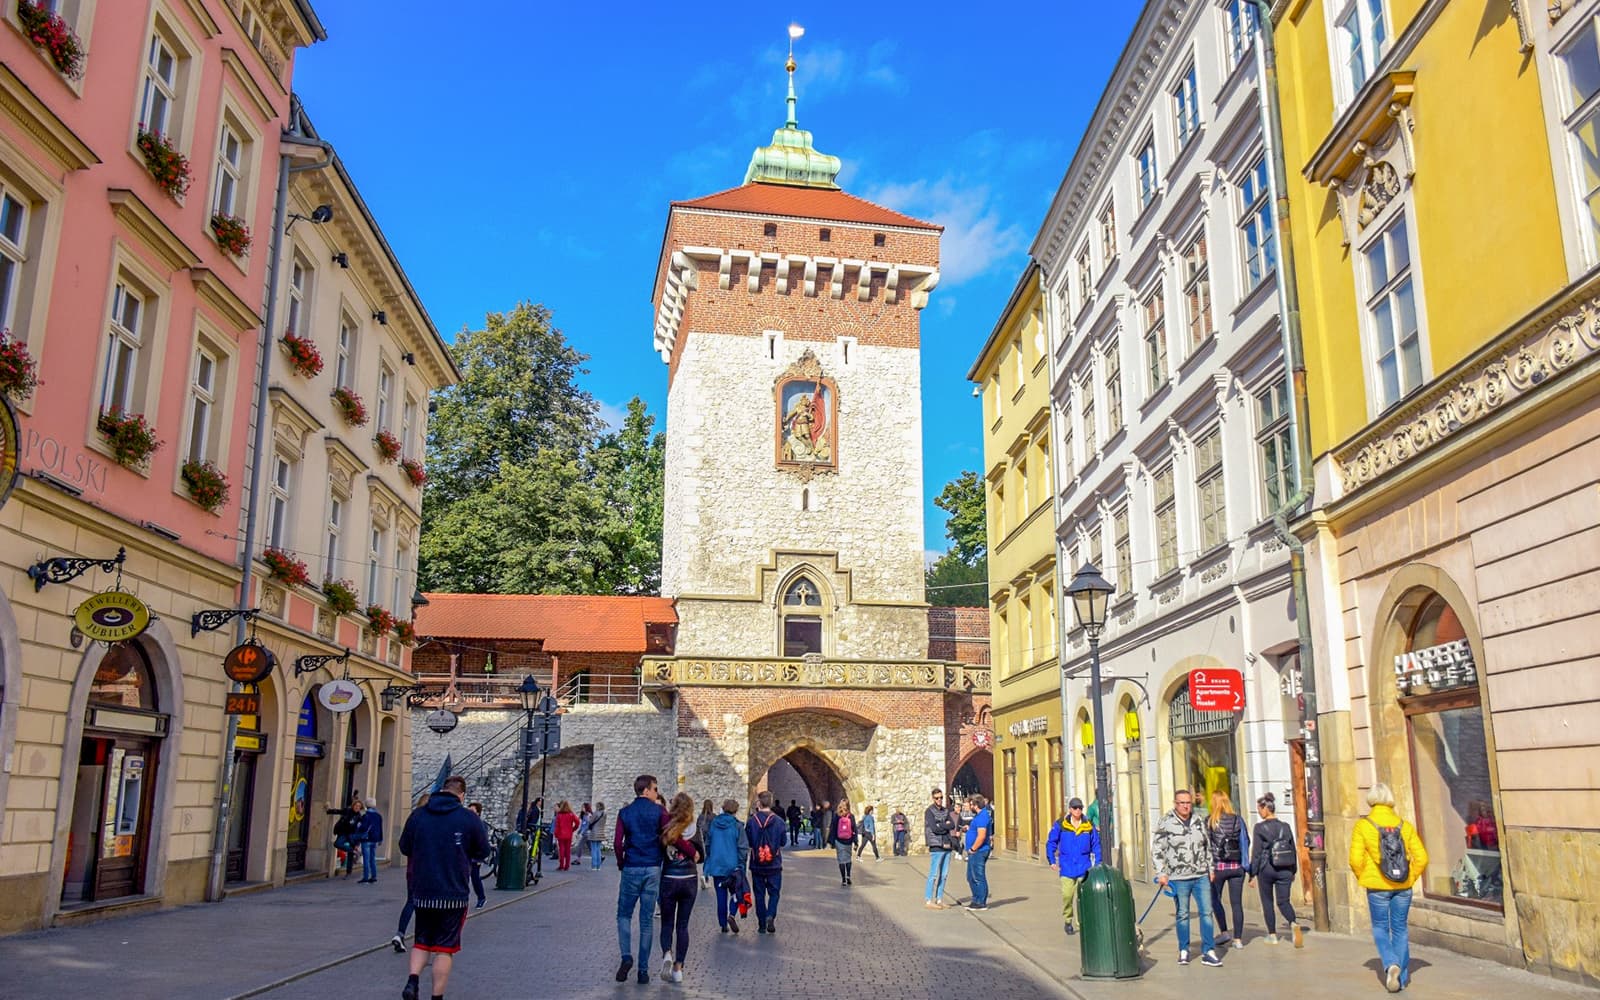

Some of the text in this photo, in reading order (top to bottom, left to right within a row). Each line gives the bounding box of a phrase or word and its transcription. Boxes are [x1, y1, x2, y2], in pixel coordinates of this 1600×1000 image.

[26, 429, 107, 494] POLSKI
[85, 596, 142, 612] JEWELLERY
[86, 623, 137, 638] JUBILER
